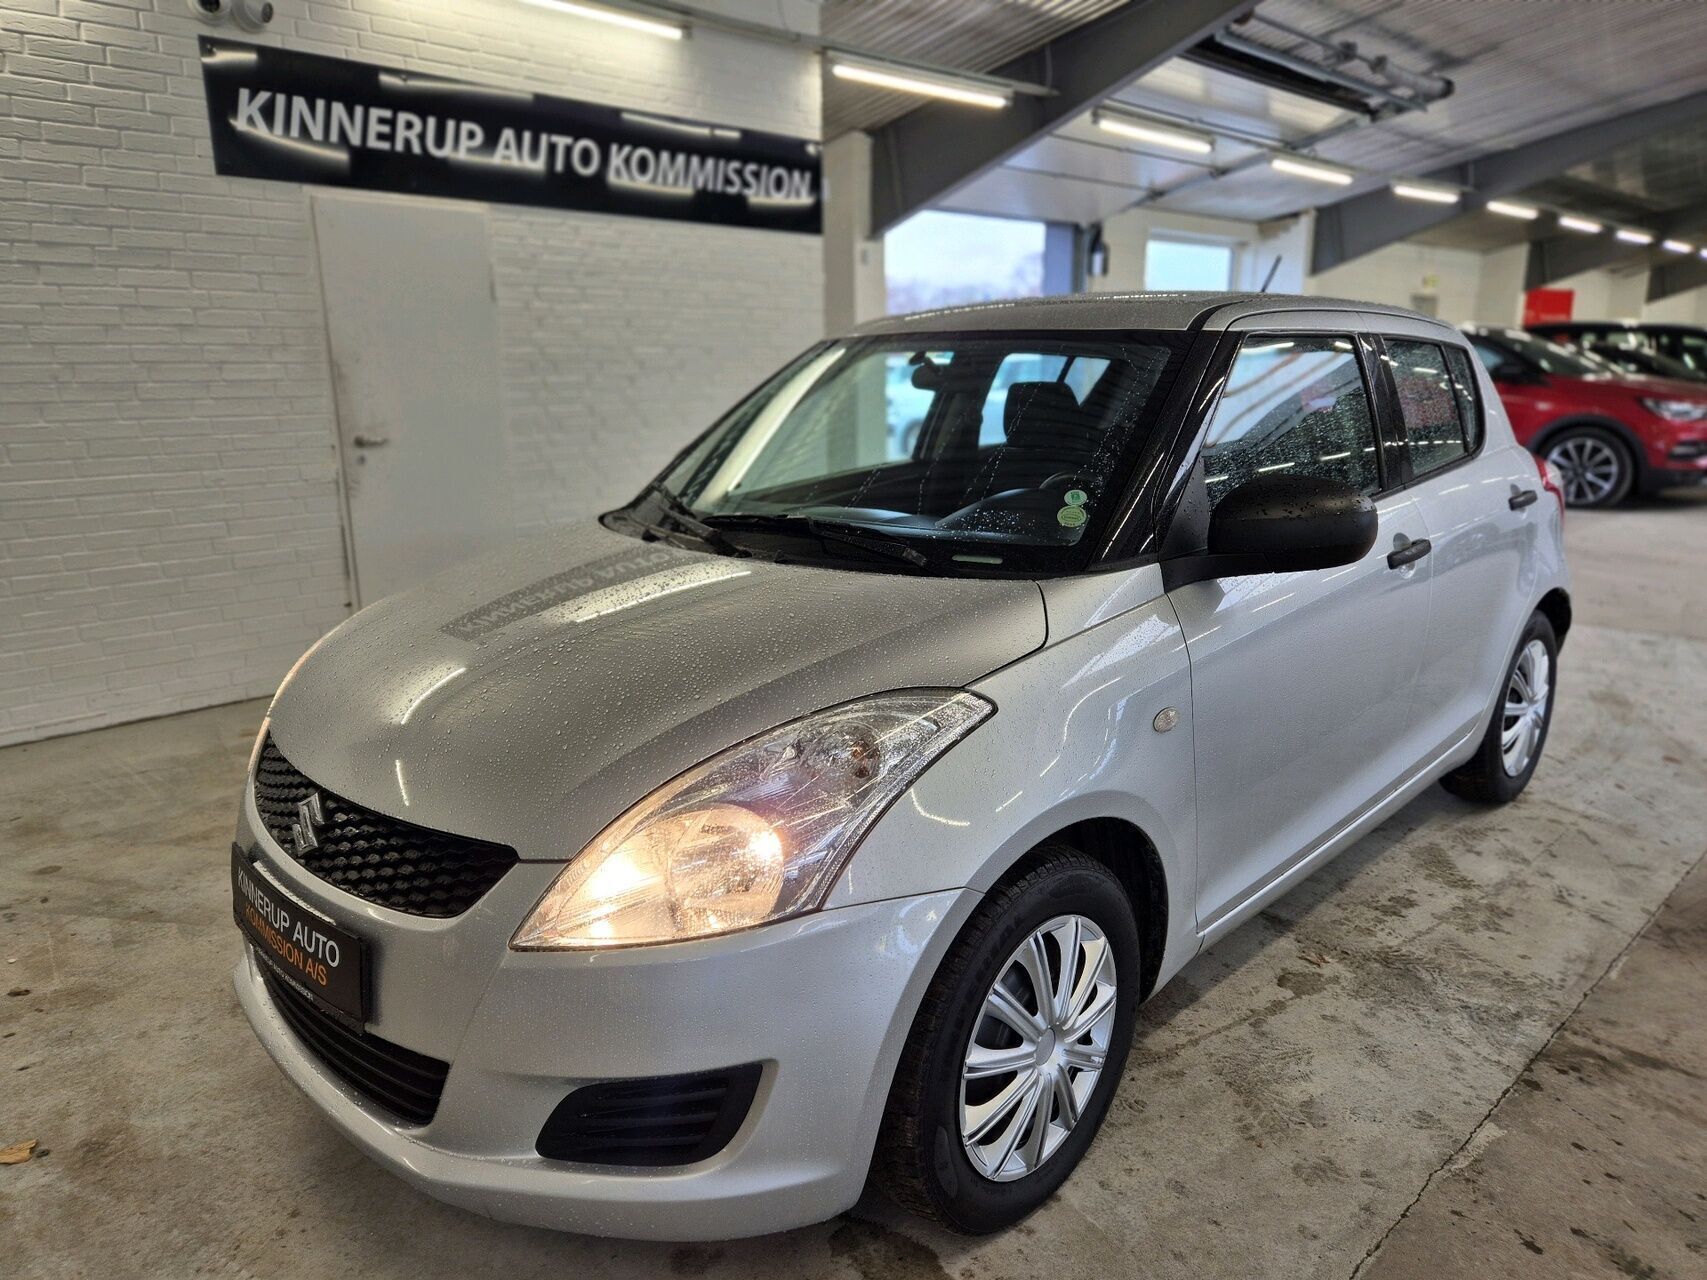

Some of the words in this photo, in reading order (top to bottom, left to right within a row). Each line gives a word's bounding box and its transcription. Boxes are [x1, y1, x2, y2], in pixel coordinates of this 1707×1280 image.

[236, 88, 484, 159] KINNERUP
[492, 127, 600, 176] AUTO
[607, 142, 812, 199] KOMMISSION
[238, 866, 290, 933] KINNERUP
[292, 921, 340, 968] AUTO
[245, 903, 304, 970] KOMMISSION
[305, 958, 328, 986] A/S
